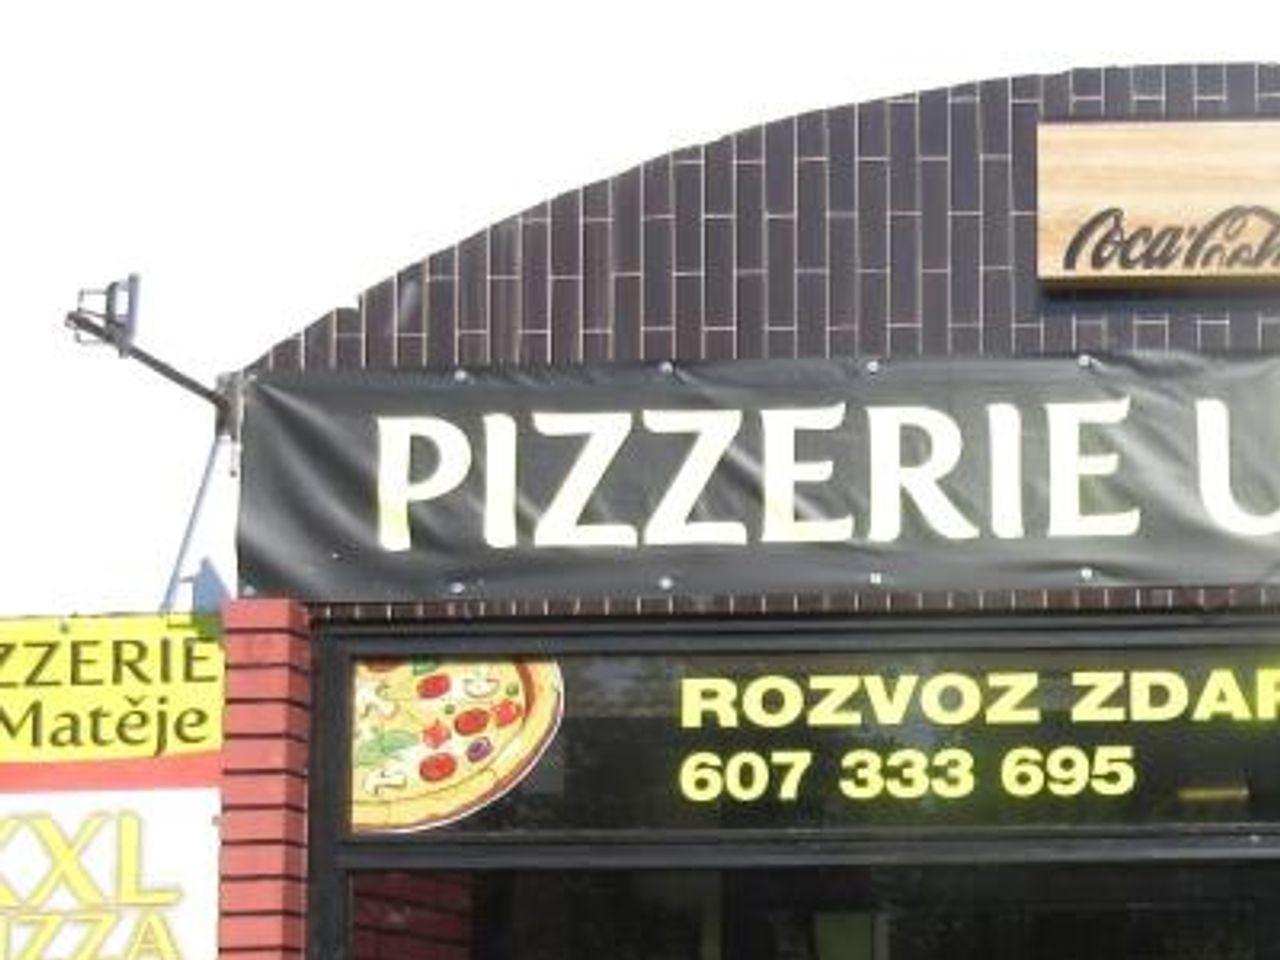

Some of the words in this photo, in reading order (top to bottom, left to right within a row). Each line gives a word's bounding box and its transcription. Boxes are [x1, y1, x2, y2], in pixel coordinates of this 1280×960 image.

[376, 396, 1141, 553] PIZZERIE
[0, 696, 208, 756] Matěje
[680, 672, 1041, 729] ROZVOZ
[679, 750, 812, 801] 607
[838, 747, 976, 799] 333
[1000, 745, 1136, 797] 695
